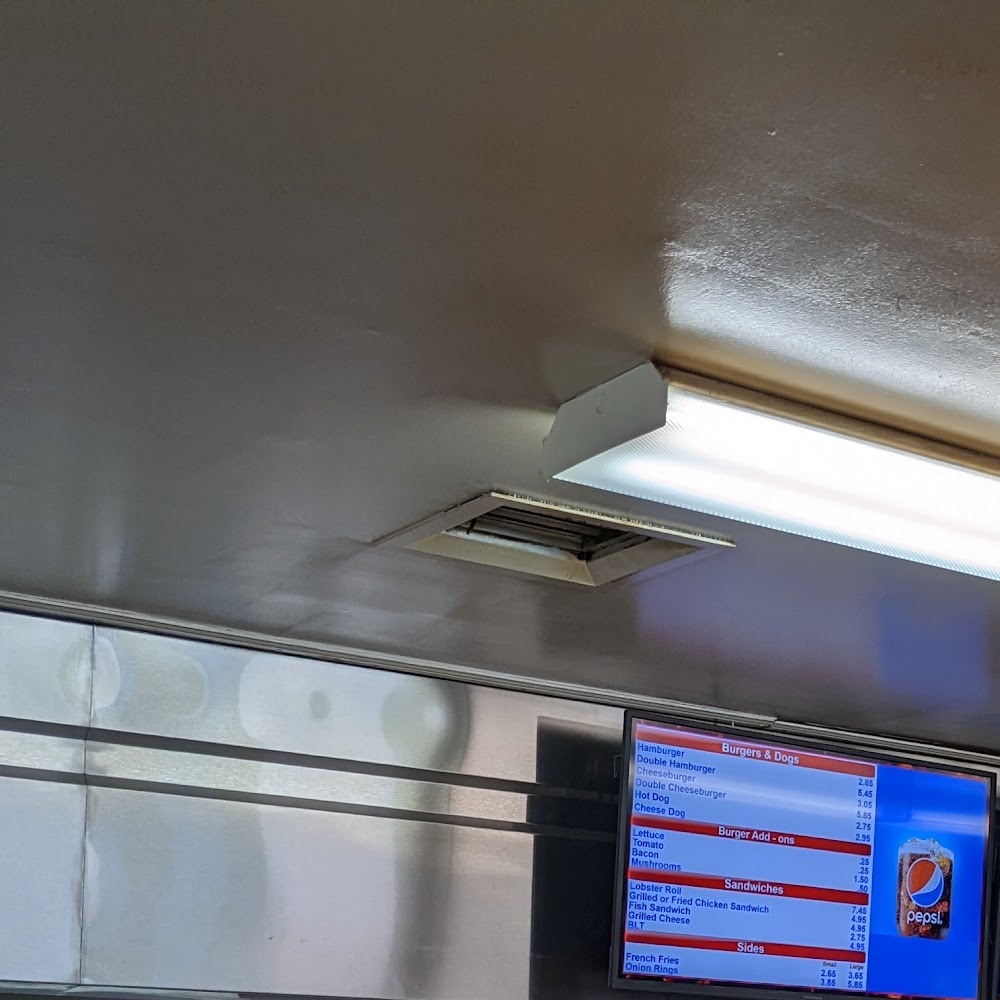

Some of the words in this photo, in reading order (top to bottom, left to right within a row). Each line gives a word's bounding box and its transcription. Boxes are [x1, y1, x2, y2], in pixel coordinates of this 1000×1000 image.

[637, 742, 685, 758] Hamburger
[722, 742, 762, 759] Burgers
[763, 751, 772, 760] &
[774, 752, 800, 766] Dogs
[636, 754, 667, 766] Double
[669, 759, 716, 774] Hamburger
[636, 766, 696, 783] Cheeseburger
[635, 778, 666, 790] Double
[668, 783, 727, 800] Cheeseburger
[858, 778, 874, 787] 2.85
[634, 790, 650, 801] Hot
[652, 792, 670, 805] Dog
[857, 789, 873, 798] 5.45
[634, 802, 666, 815] Cheese
[668, 807, 686, 819] Dog
[857, 800, 873, 809] 3.05
[856, 822, 871, 831] 2.75
[632, 828, 665, 840] Lettuce
[718, 826, 751, 840] Burger
[751, 830, 770, 842] Add
[777, 836, 795, 846] ons
[855, 833, 871, 842] 2.95
[632, 838, 664, 850] Tomato
[632, 848, 659, 859] Bacon
[631, 858, 682, 871] Mushrooms
[630, 882, 663, 893] Lobster
[665, 885, 682, 895] Roll
[724, 878, 784, 895] Sandwiches
[629, 892, 657, 902] Grilled
[660, 895, 669, 903] or
[671, 896, 693, 906] Fried
[695, 898, 728, 909] Chicken
[730, 902, 769, 914] Sandwich
[629, 901, 647, 911] Fish
[649, 903, 691, 915] Sandwich
[851, 906, 867, 915] 7.45
[628, 911, 657, 922] Grilled
[659, 914, 691, 925] Cheese
[851, 915, 867, 924] 4.95
[628, 920, 645, 930] BLT
[850, 924, 866, 933] 4.95
[850, 933, 865, 942] 2.75
[737, 942, 765, 954] Sides
[849, 942, 865, 951] 4.95
[626, 952, 656, 963] French
[658, 955, 679, 965] Fries
[625, 962, 652, 972] Onion
[654, 964, 679, 975] Rings
